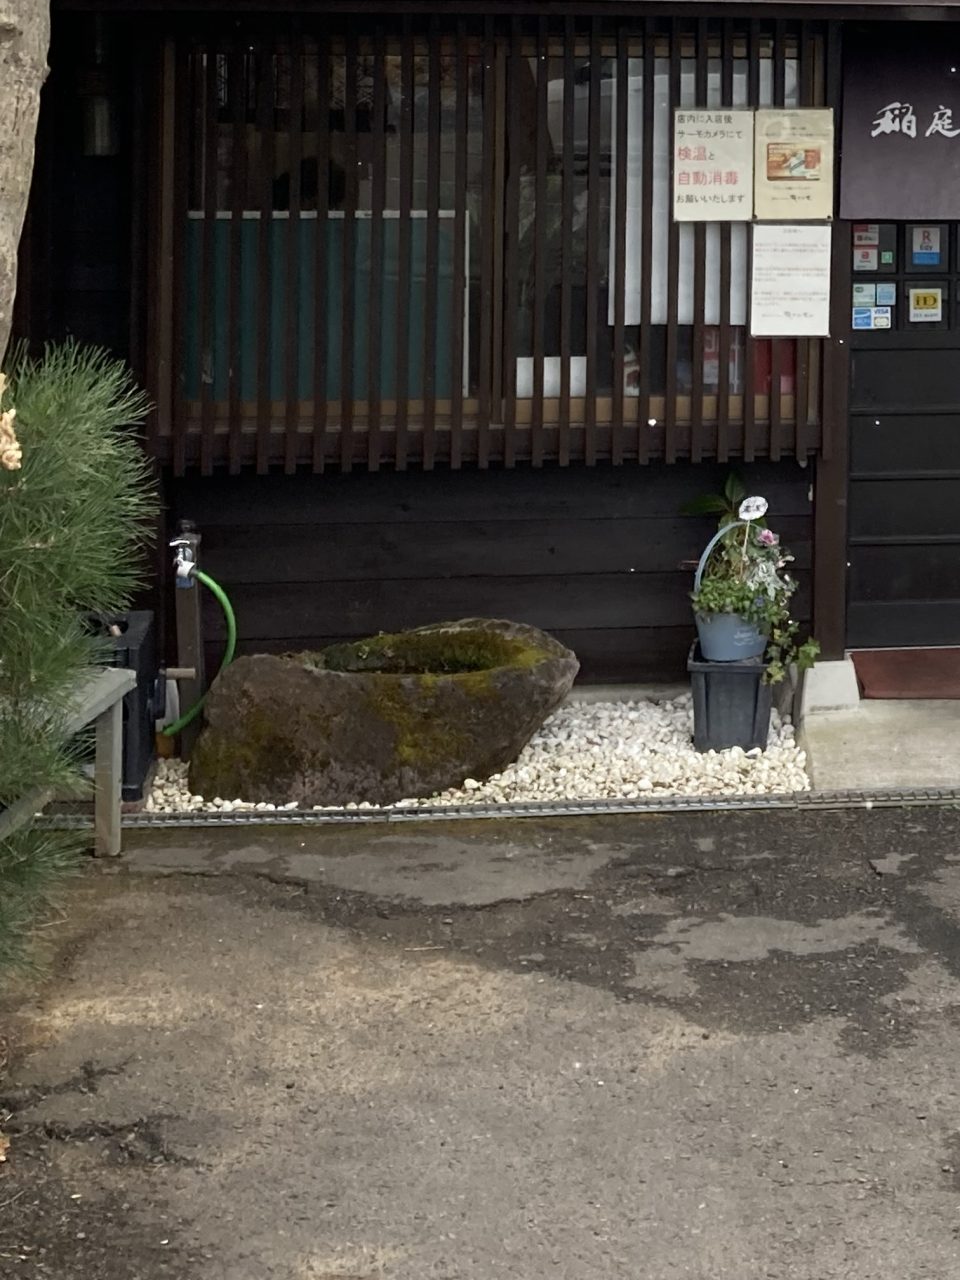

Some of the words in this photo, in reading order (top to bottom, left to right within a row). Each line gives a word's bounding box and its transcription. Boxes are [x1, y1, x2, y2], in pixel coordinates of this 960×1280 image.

[677, 130, 743, 139] サーモカメラにて
[678, 146, 715, 161] 検温と
[678, 170, 739, 186] 自動消毒
[676, 194, 745, 204] お願いいたします
